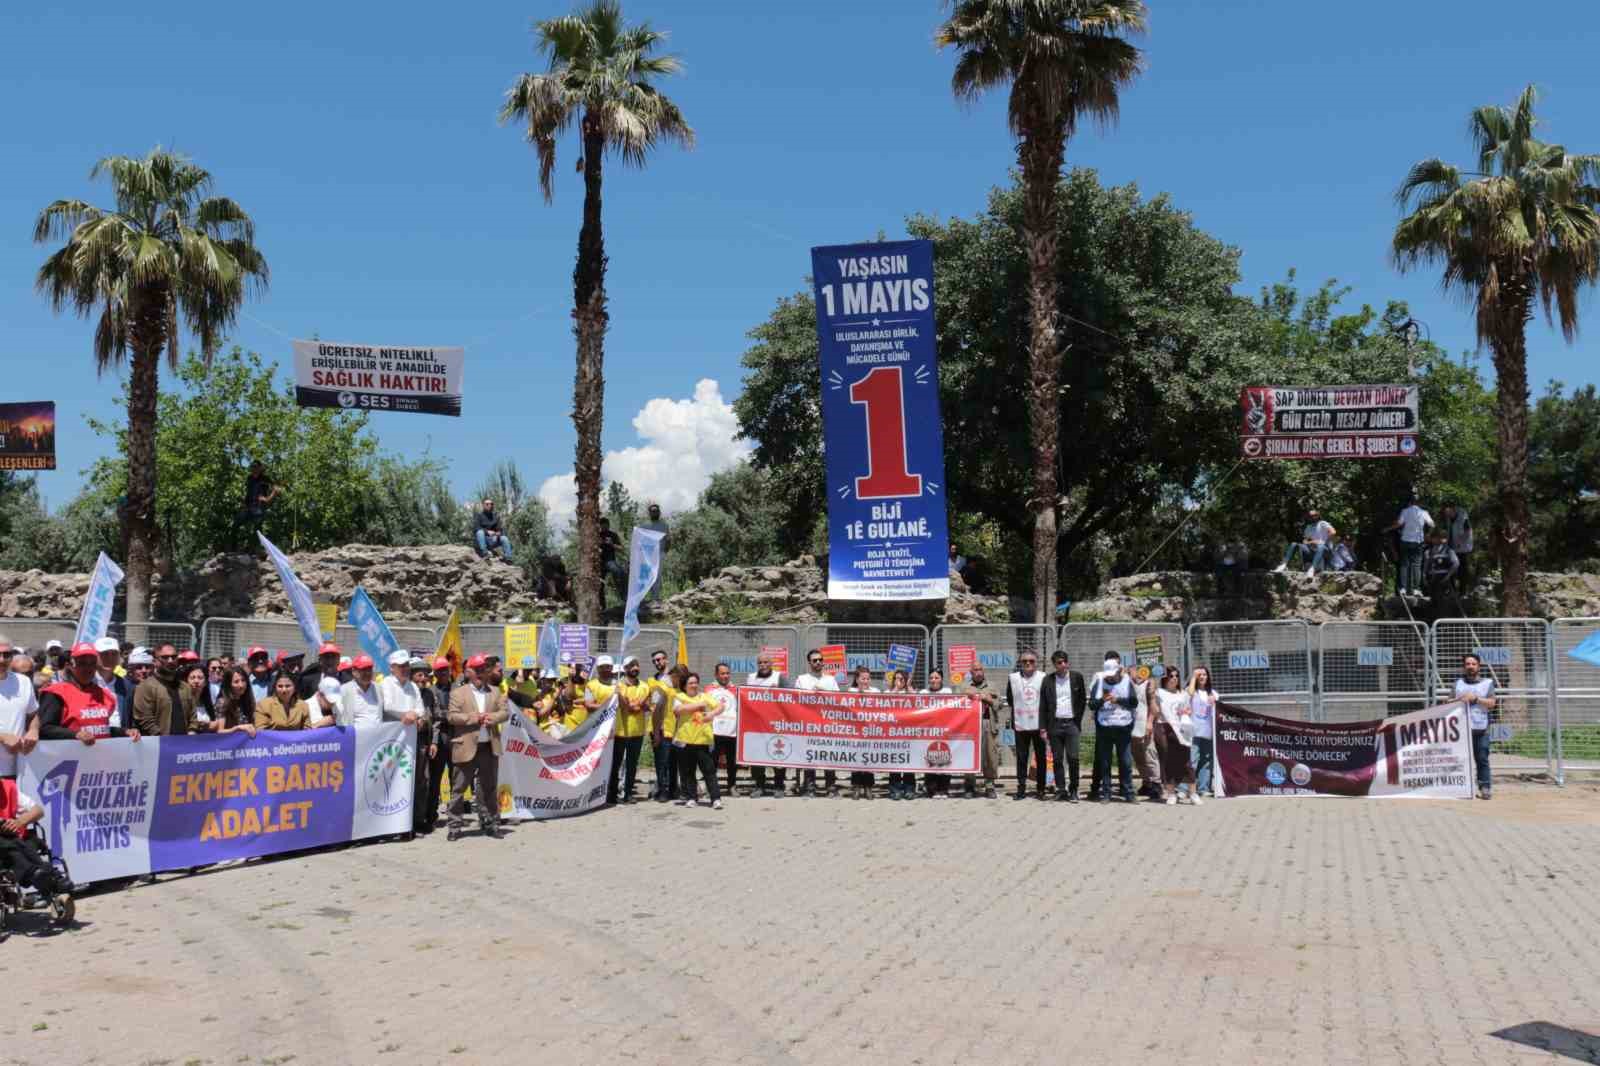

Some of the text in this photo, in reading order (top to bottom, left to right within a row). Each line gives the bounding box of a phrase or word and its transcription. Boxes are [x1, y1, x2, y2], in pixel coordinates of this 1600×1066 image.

[838, 255, 908, 279] YAŞASIN
[822, 278, 930, 316] 1 MAYIS
[319, 344, 437, 362] ÜCRETSİZ, NİTELİKLİ,
[894, 340, 904, 350] VE
[312, 358, 446, 374] ERİŞİLEBİLİR VE ANADİLDE
[313, 370, 446, 392] SAĞLIK HAKTIR!
[360, 394, 390, 408] SES
[1275, 391, 1294, 407] SAP
[850, 365, 922, 499] 1
[859, 698, 872, 707] VE
[876, 698, 912, 708] HATTA
[807, 724, 822, 732] EN
[824, 722, 858, 735] GÜZEL
[1400, 716, 1460, 746] MAYIS
[806, 750, 856, 762] ŞIRNAK
[862, 751, 911, 764] ŞUBESİ
[168, 760, 344, 804] EKMEK BARIŞ
[200, 801, 312, 841] ADALET
[76, 826, 130, 854] MAYIS
